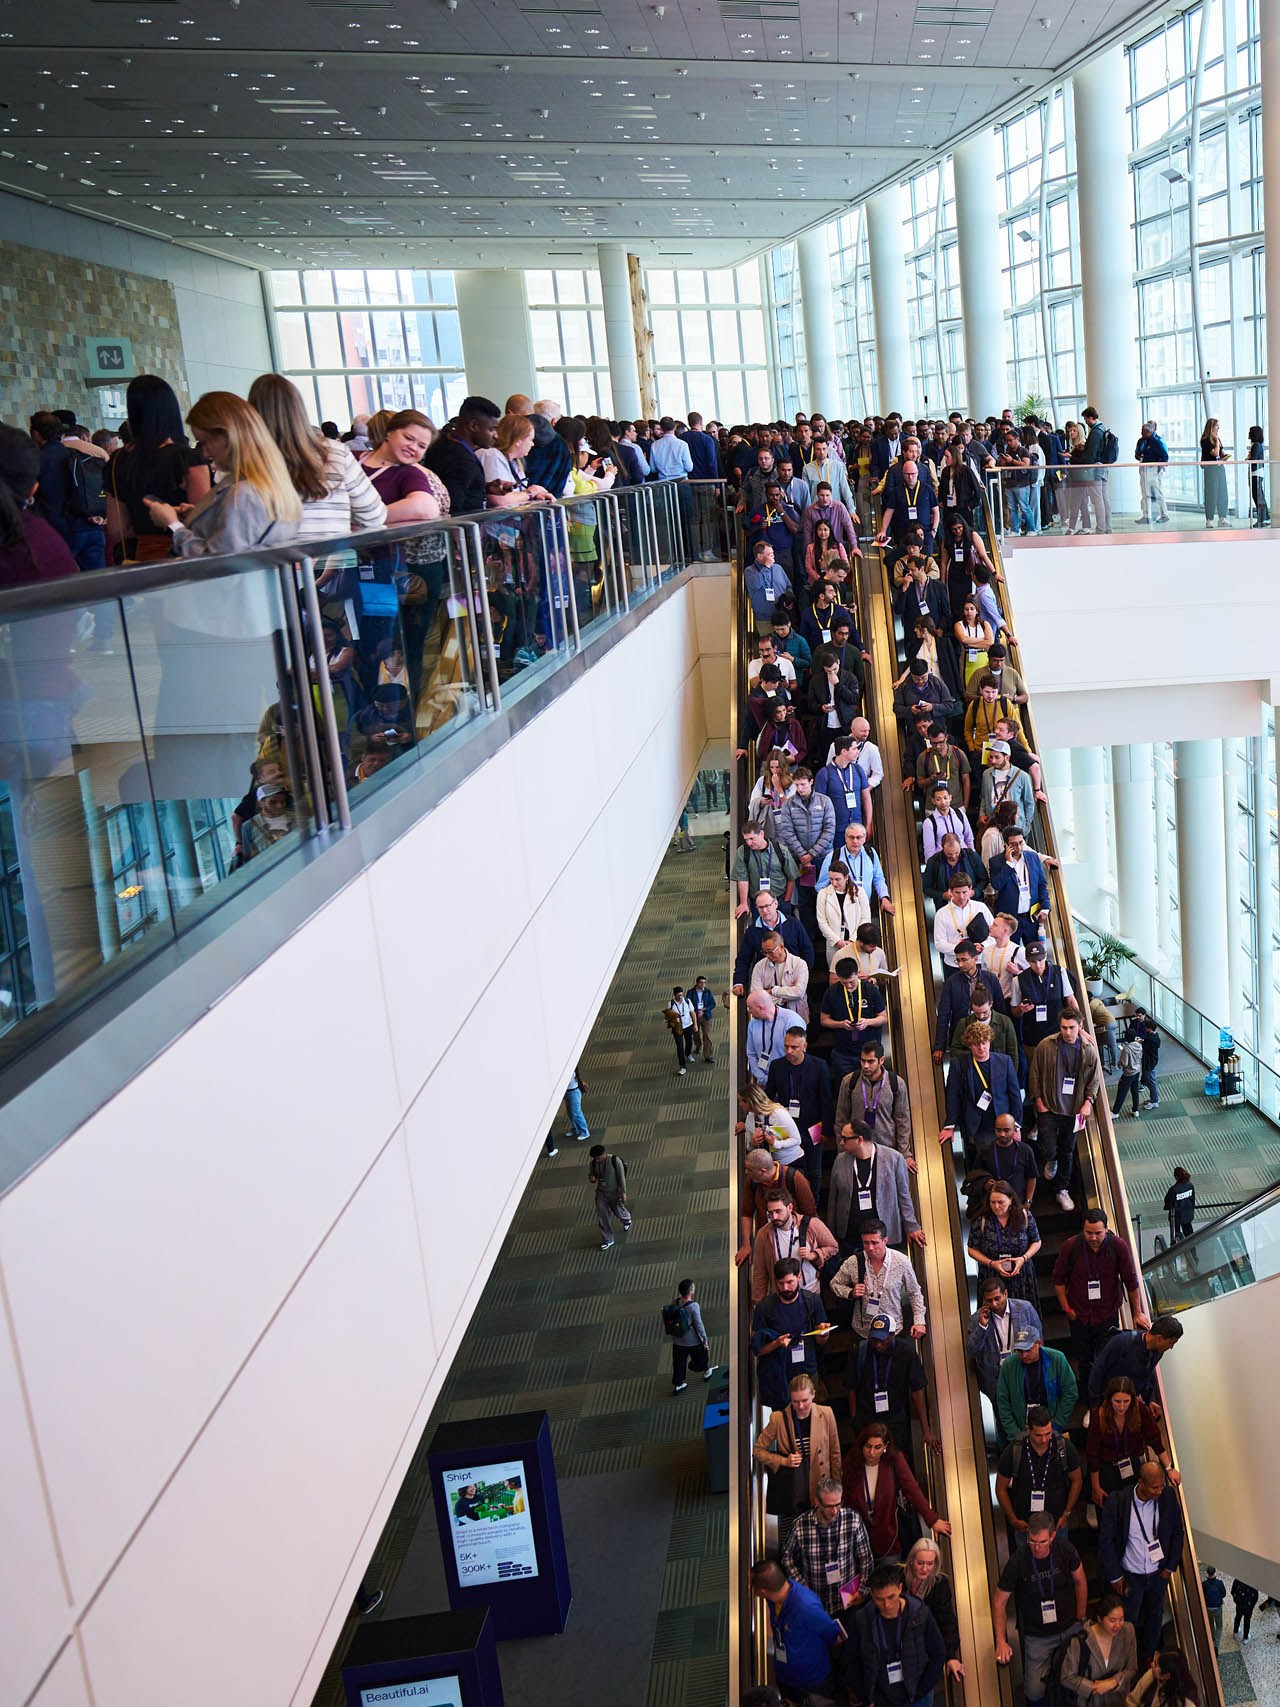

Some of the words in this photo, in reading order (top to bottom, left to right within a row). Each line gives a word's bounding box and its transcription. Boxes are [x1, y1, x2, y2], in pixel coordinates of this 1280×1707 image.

[446, 1472, 472, 1482] Shipt
[460, 1552, 478, 1561] 5K+
[462, 1563, 491, 1573] 300K+
[366, 1684, 429, 1702] Beautiful.ai
